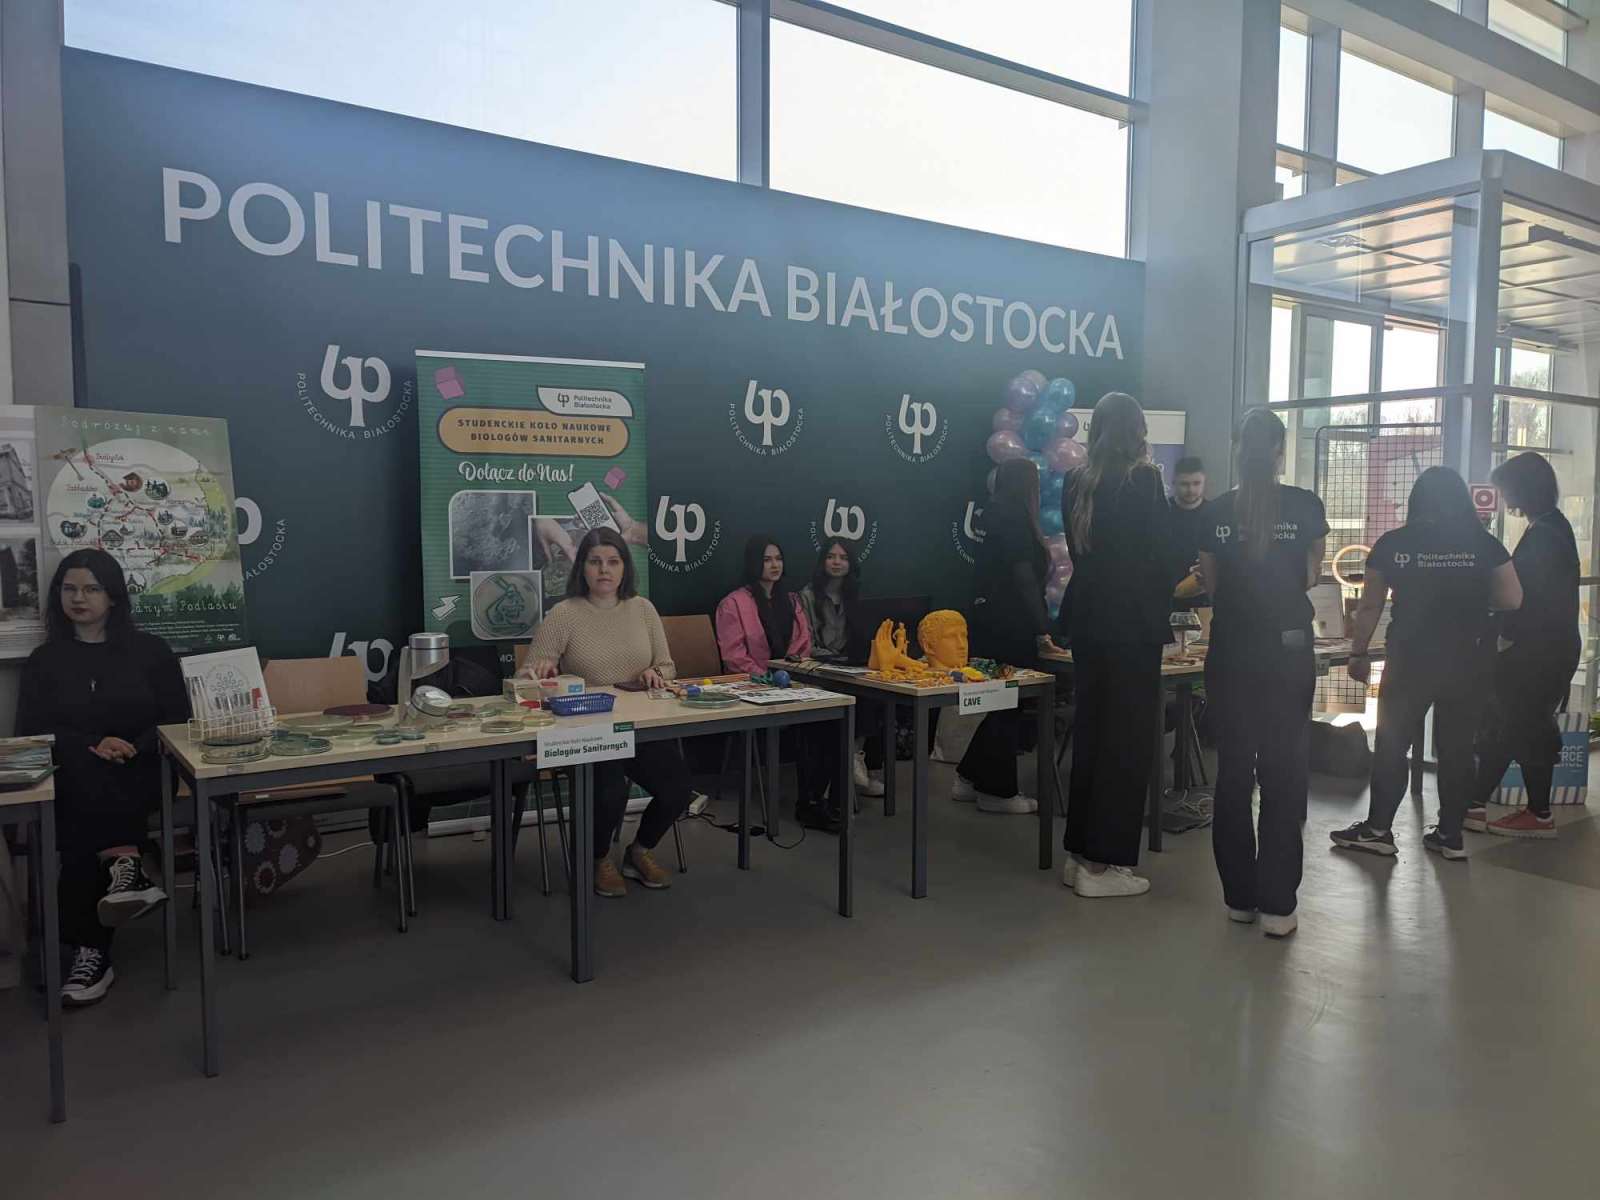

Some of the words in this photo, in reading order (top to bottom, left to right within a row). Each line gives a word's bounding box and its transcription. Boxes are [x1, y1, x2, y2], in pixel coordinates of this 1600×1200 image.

[163, 167, 771, 317] POLITECHNIKA
[787, 265, 1124, 360] BIAŁOSTOCKA
[297, 372, 355, 439] POLITECHNIKA
[363, 380, 413, 439] BIAŁOSTOCKA
[457, 419, 525, 429] STUDENCKIE
[529, 422, 558, 430] KOŁO
[562, 423, 612, 433] NAUKOWE
[470, 432, 529, 442] BIOLOGÓW
[532, 433, 604, 445] SANITARNYCH
[458, 461, 516, 484] Dołącz
[518, 463, 536, 482] do
[536, 464, 575, 482] Nas!
[245, 519, 287, 580] AŁOSTOCKA
[963, 696, 982, 707] CAVE
[544, 747, 581, 758] Biologów
[583, 741, 628, 753] Sanitarnych
